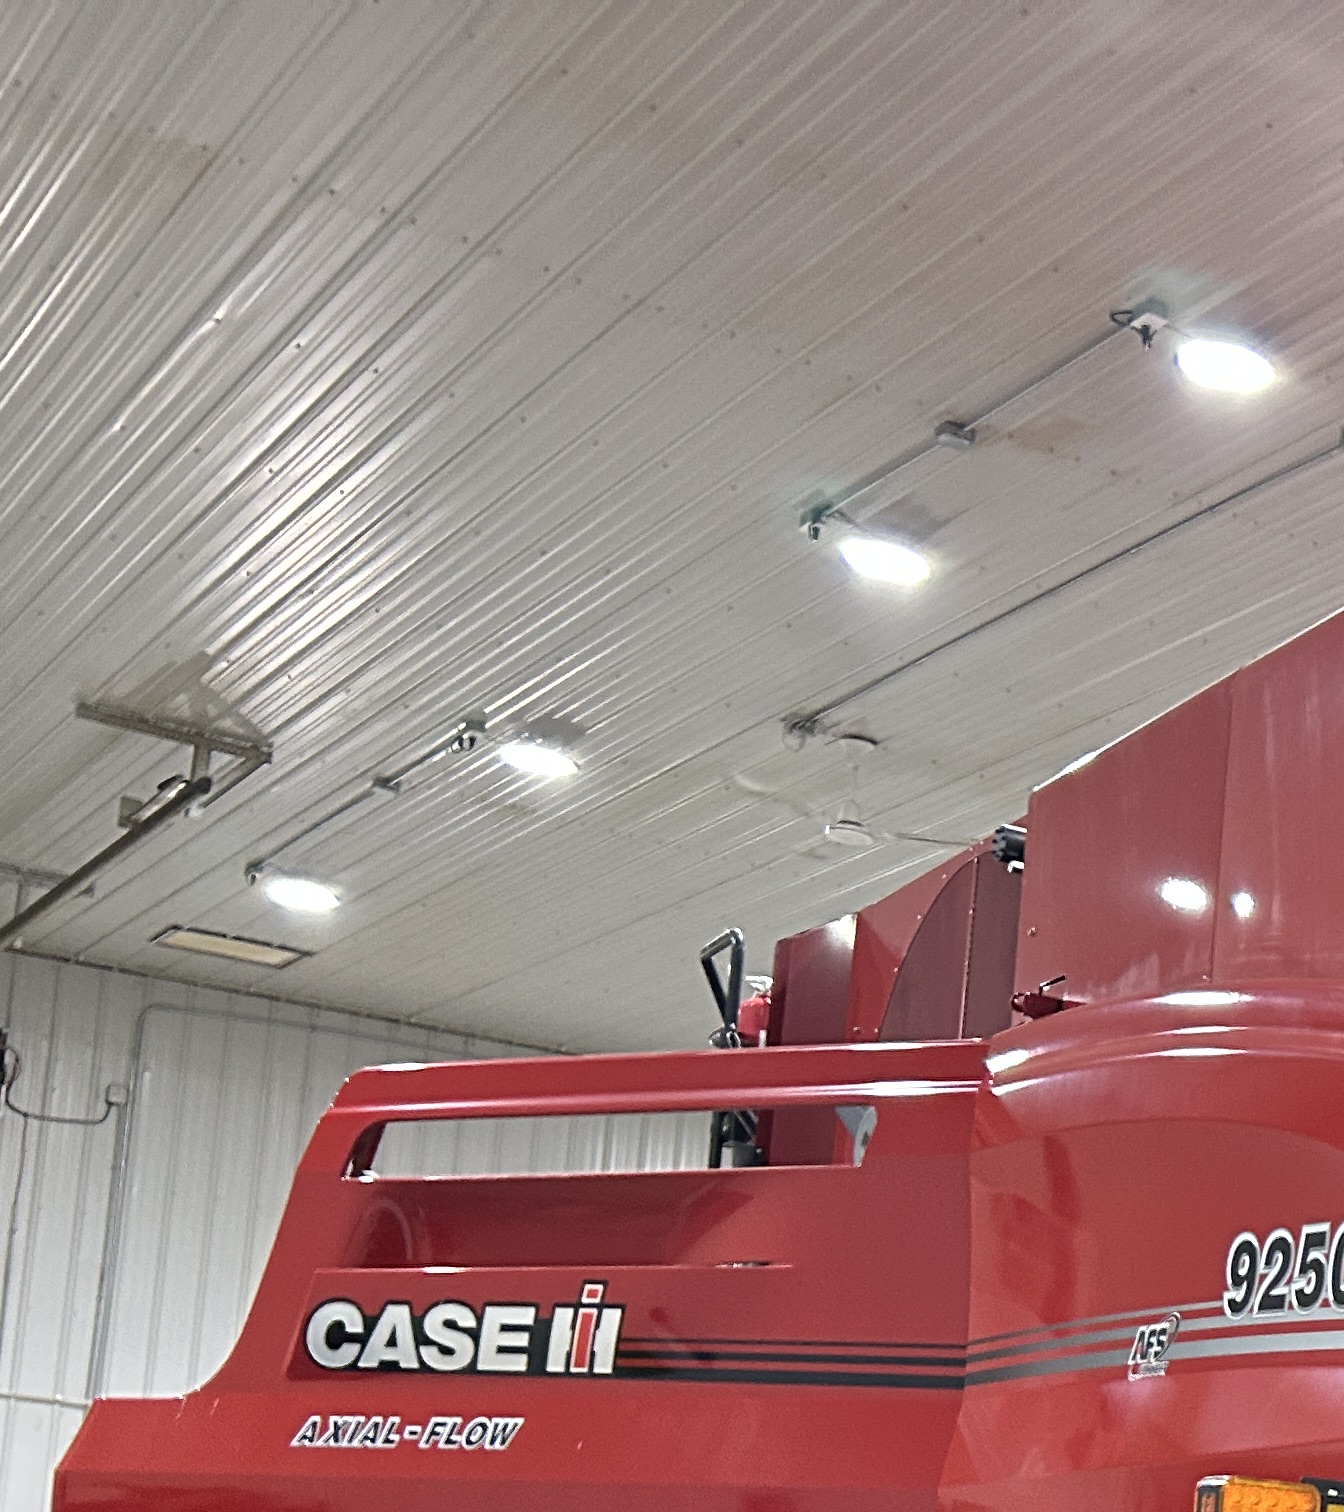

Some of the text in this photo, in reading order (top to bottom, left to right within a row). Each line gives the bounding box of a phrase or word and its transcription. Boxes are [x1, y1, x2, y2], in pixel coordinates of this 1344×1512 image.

[305, 1299, 537, 1373] CASE
[1127, 1321, 1170, 1365] AFS
[290, 1414, 526, 1450] AXIAL-FLOW
